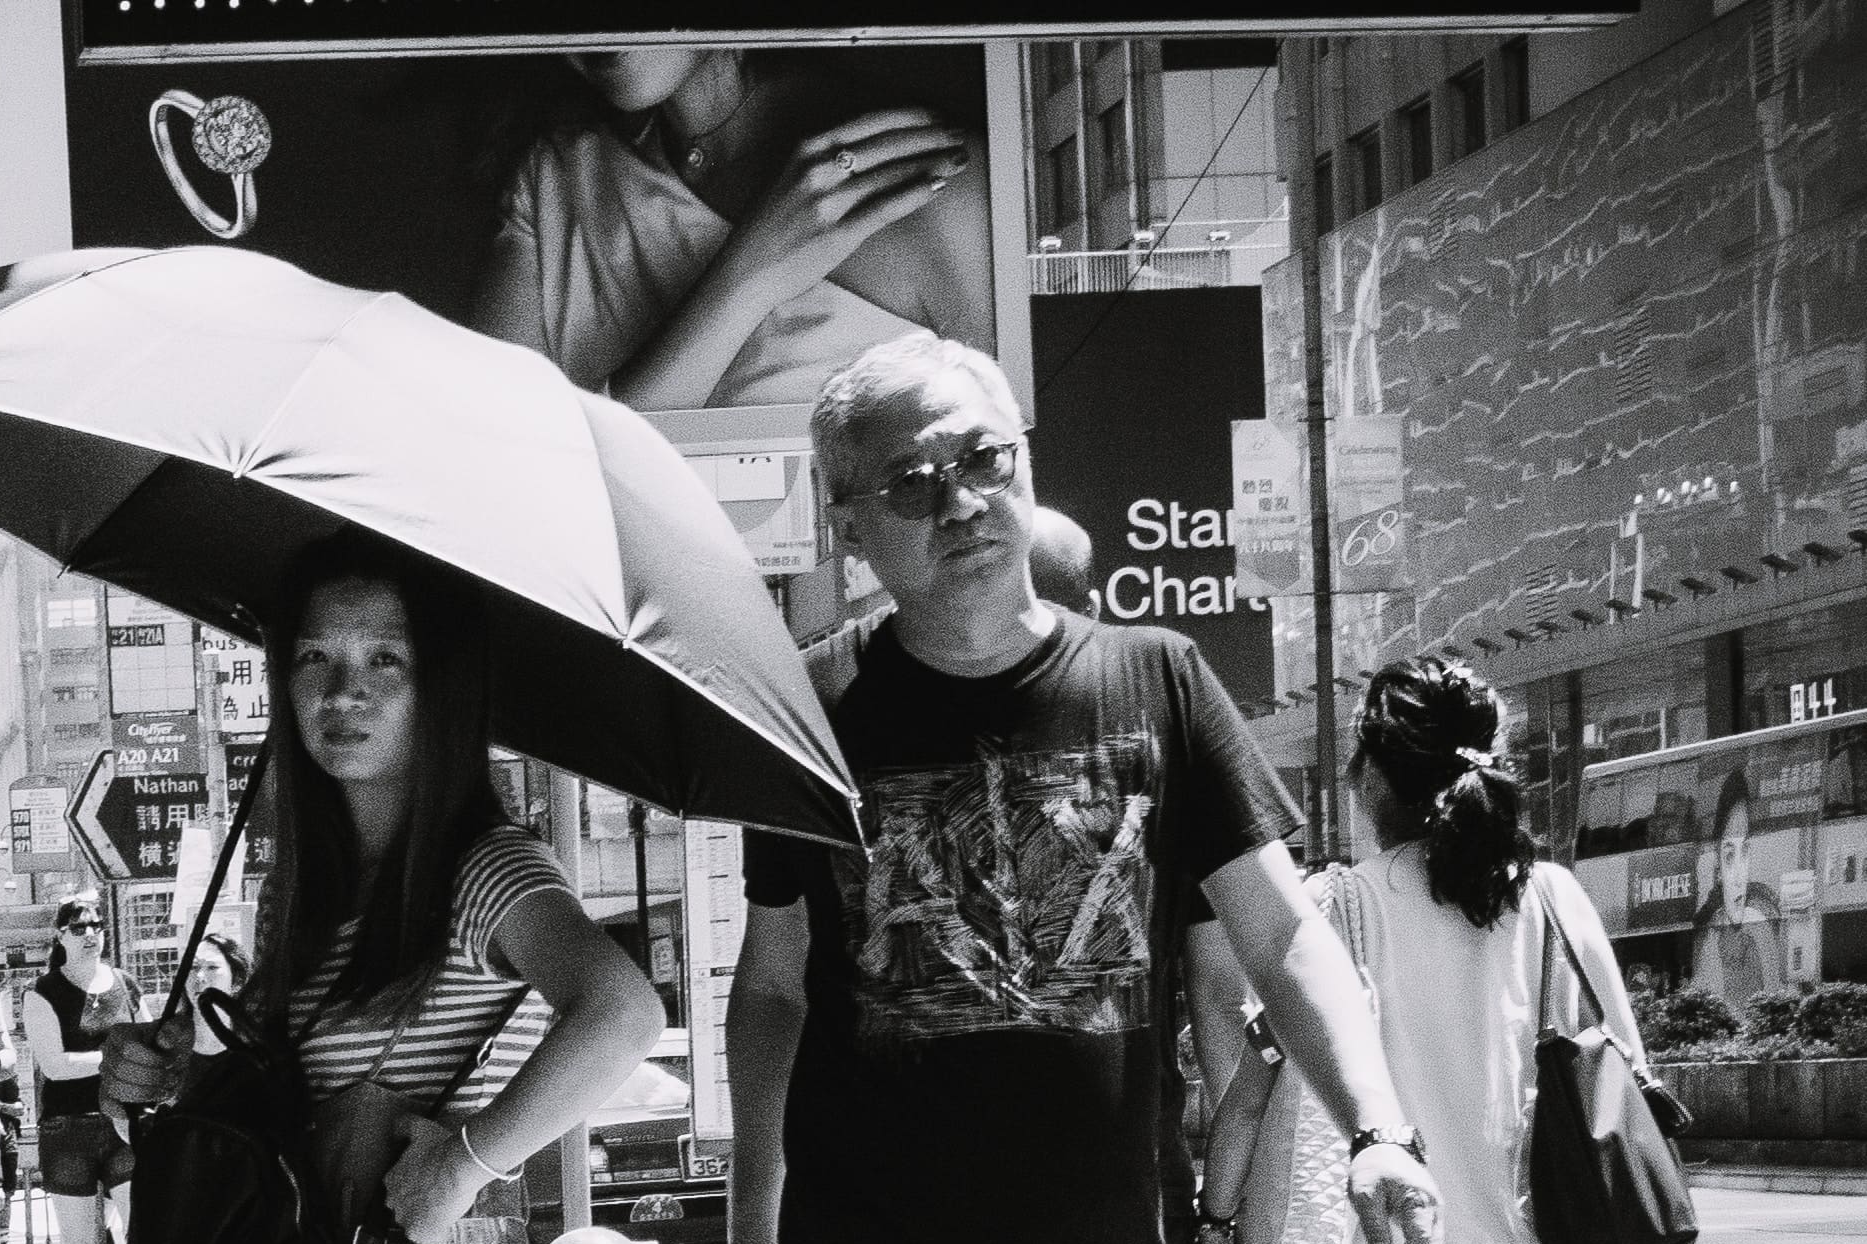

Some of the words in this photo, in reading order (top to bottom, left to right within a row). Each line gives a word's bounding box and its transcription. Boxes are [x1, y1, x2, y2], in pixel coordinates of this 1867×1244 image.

[1342, 510, 1399, 567] 68
[117, 749, 148, 765] A20
[151, 747, 180, 763] A21
[134, 776, 199, 795] Nathan
